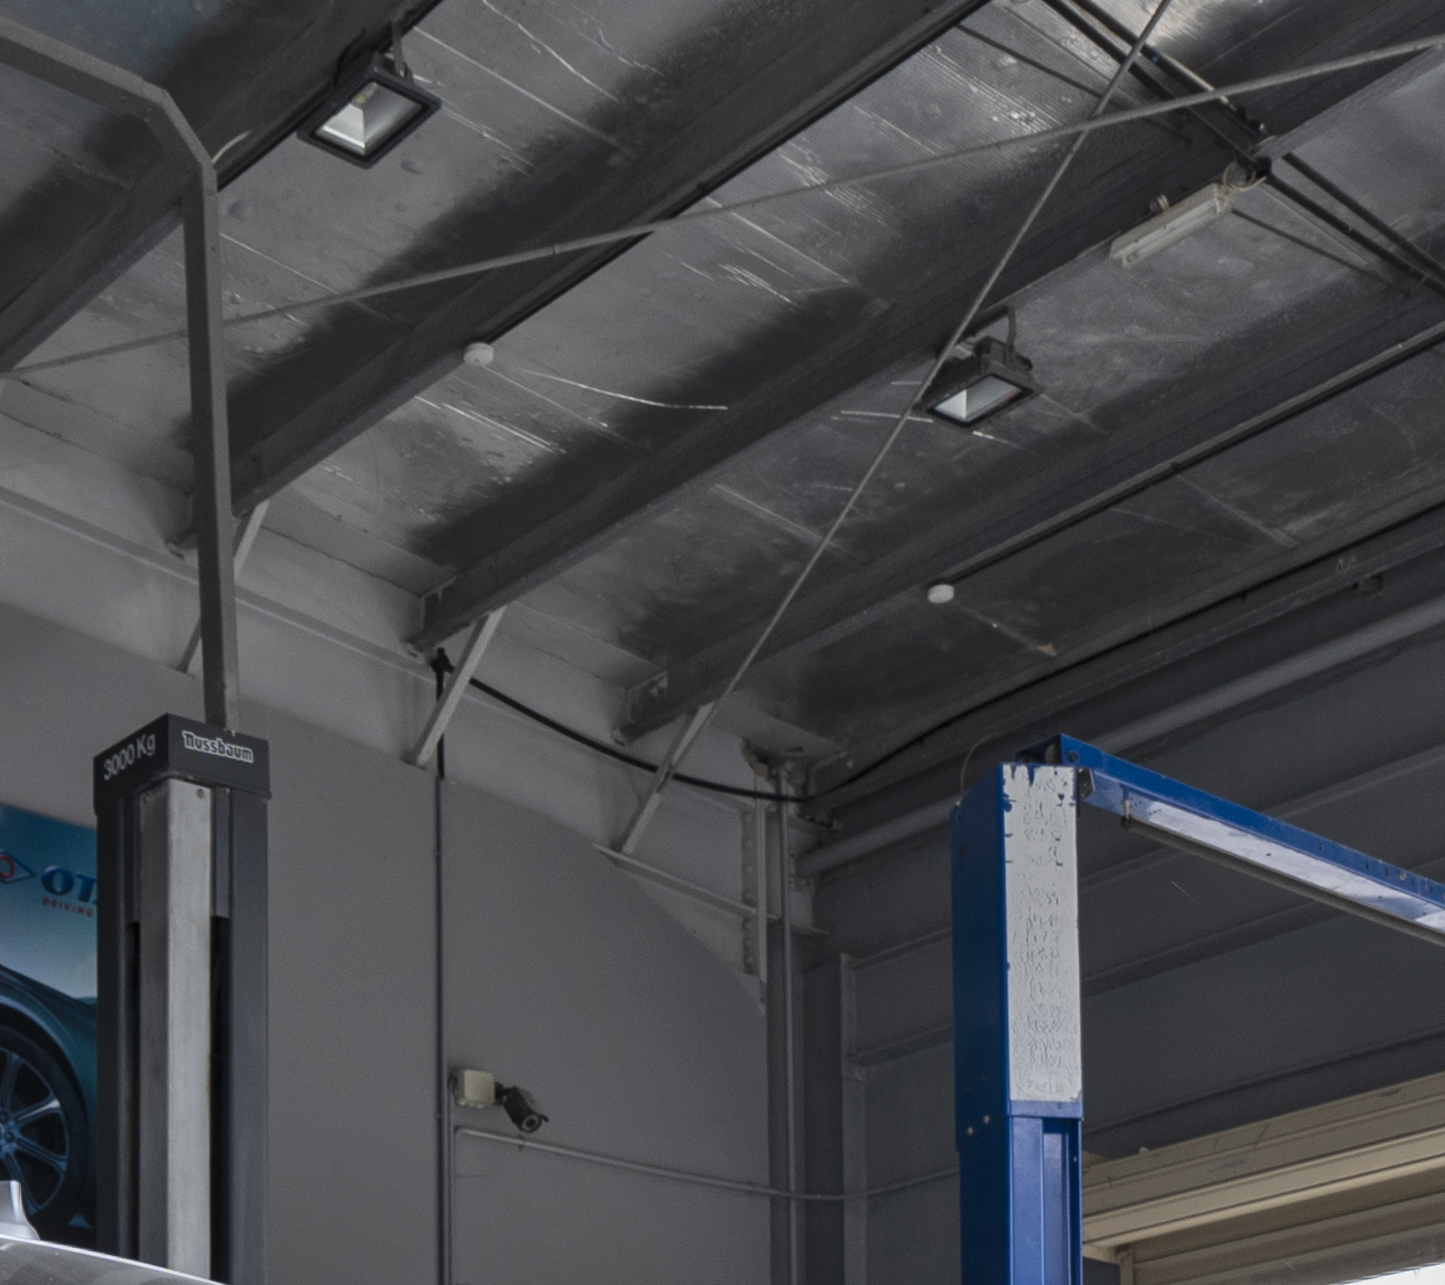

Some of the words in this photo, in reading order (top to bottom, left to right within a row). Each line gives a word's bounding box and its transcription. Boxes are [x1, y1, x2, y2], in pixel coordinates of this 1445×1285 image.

[103, 743, 135, 781] 3000
[135, 732, 157, 761] Kg
[181, 730, 254, 764] Nussbaum
[41, 865, 96, 904] OT
[41, 897, 94, 917] DRIVING
